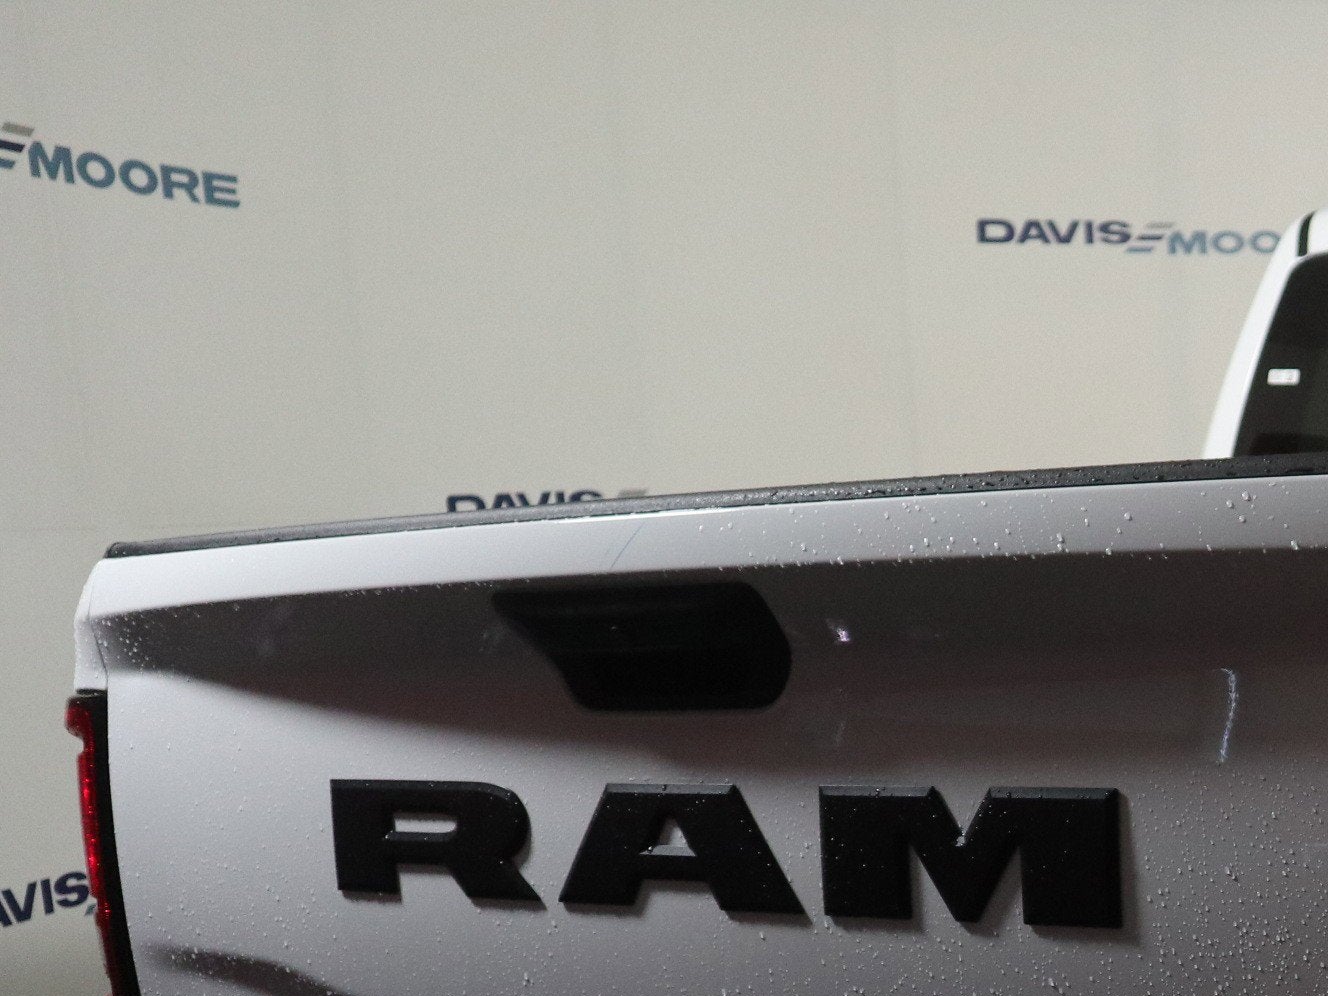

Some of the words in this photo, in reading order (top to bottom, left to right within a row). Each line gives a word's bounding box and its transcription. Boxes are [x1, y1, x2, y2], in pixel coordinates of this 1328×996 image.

[27, 141, 241, 209] MOORE
[976, 219, 1132, 244] DAVIS
[330, 778, 1126, 928] RAM
